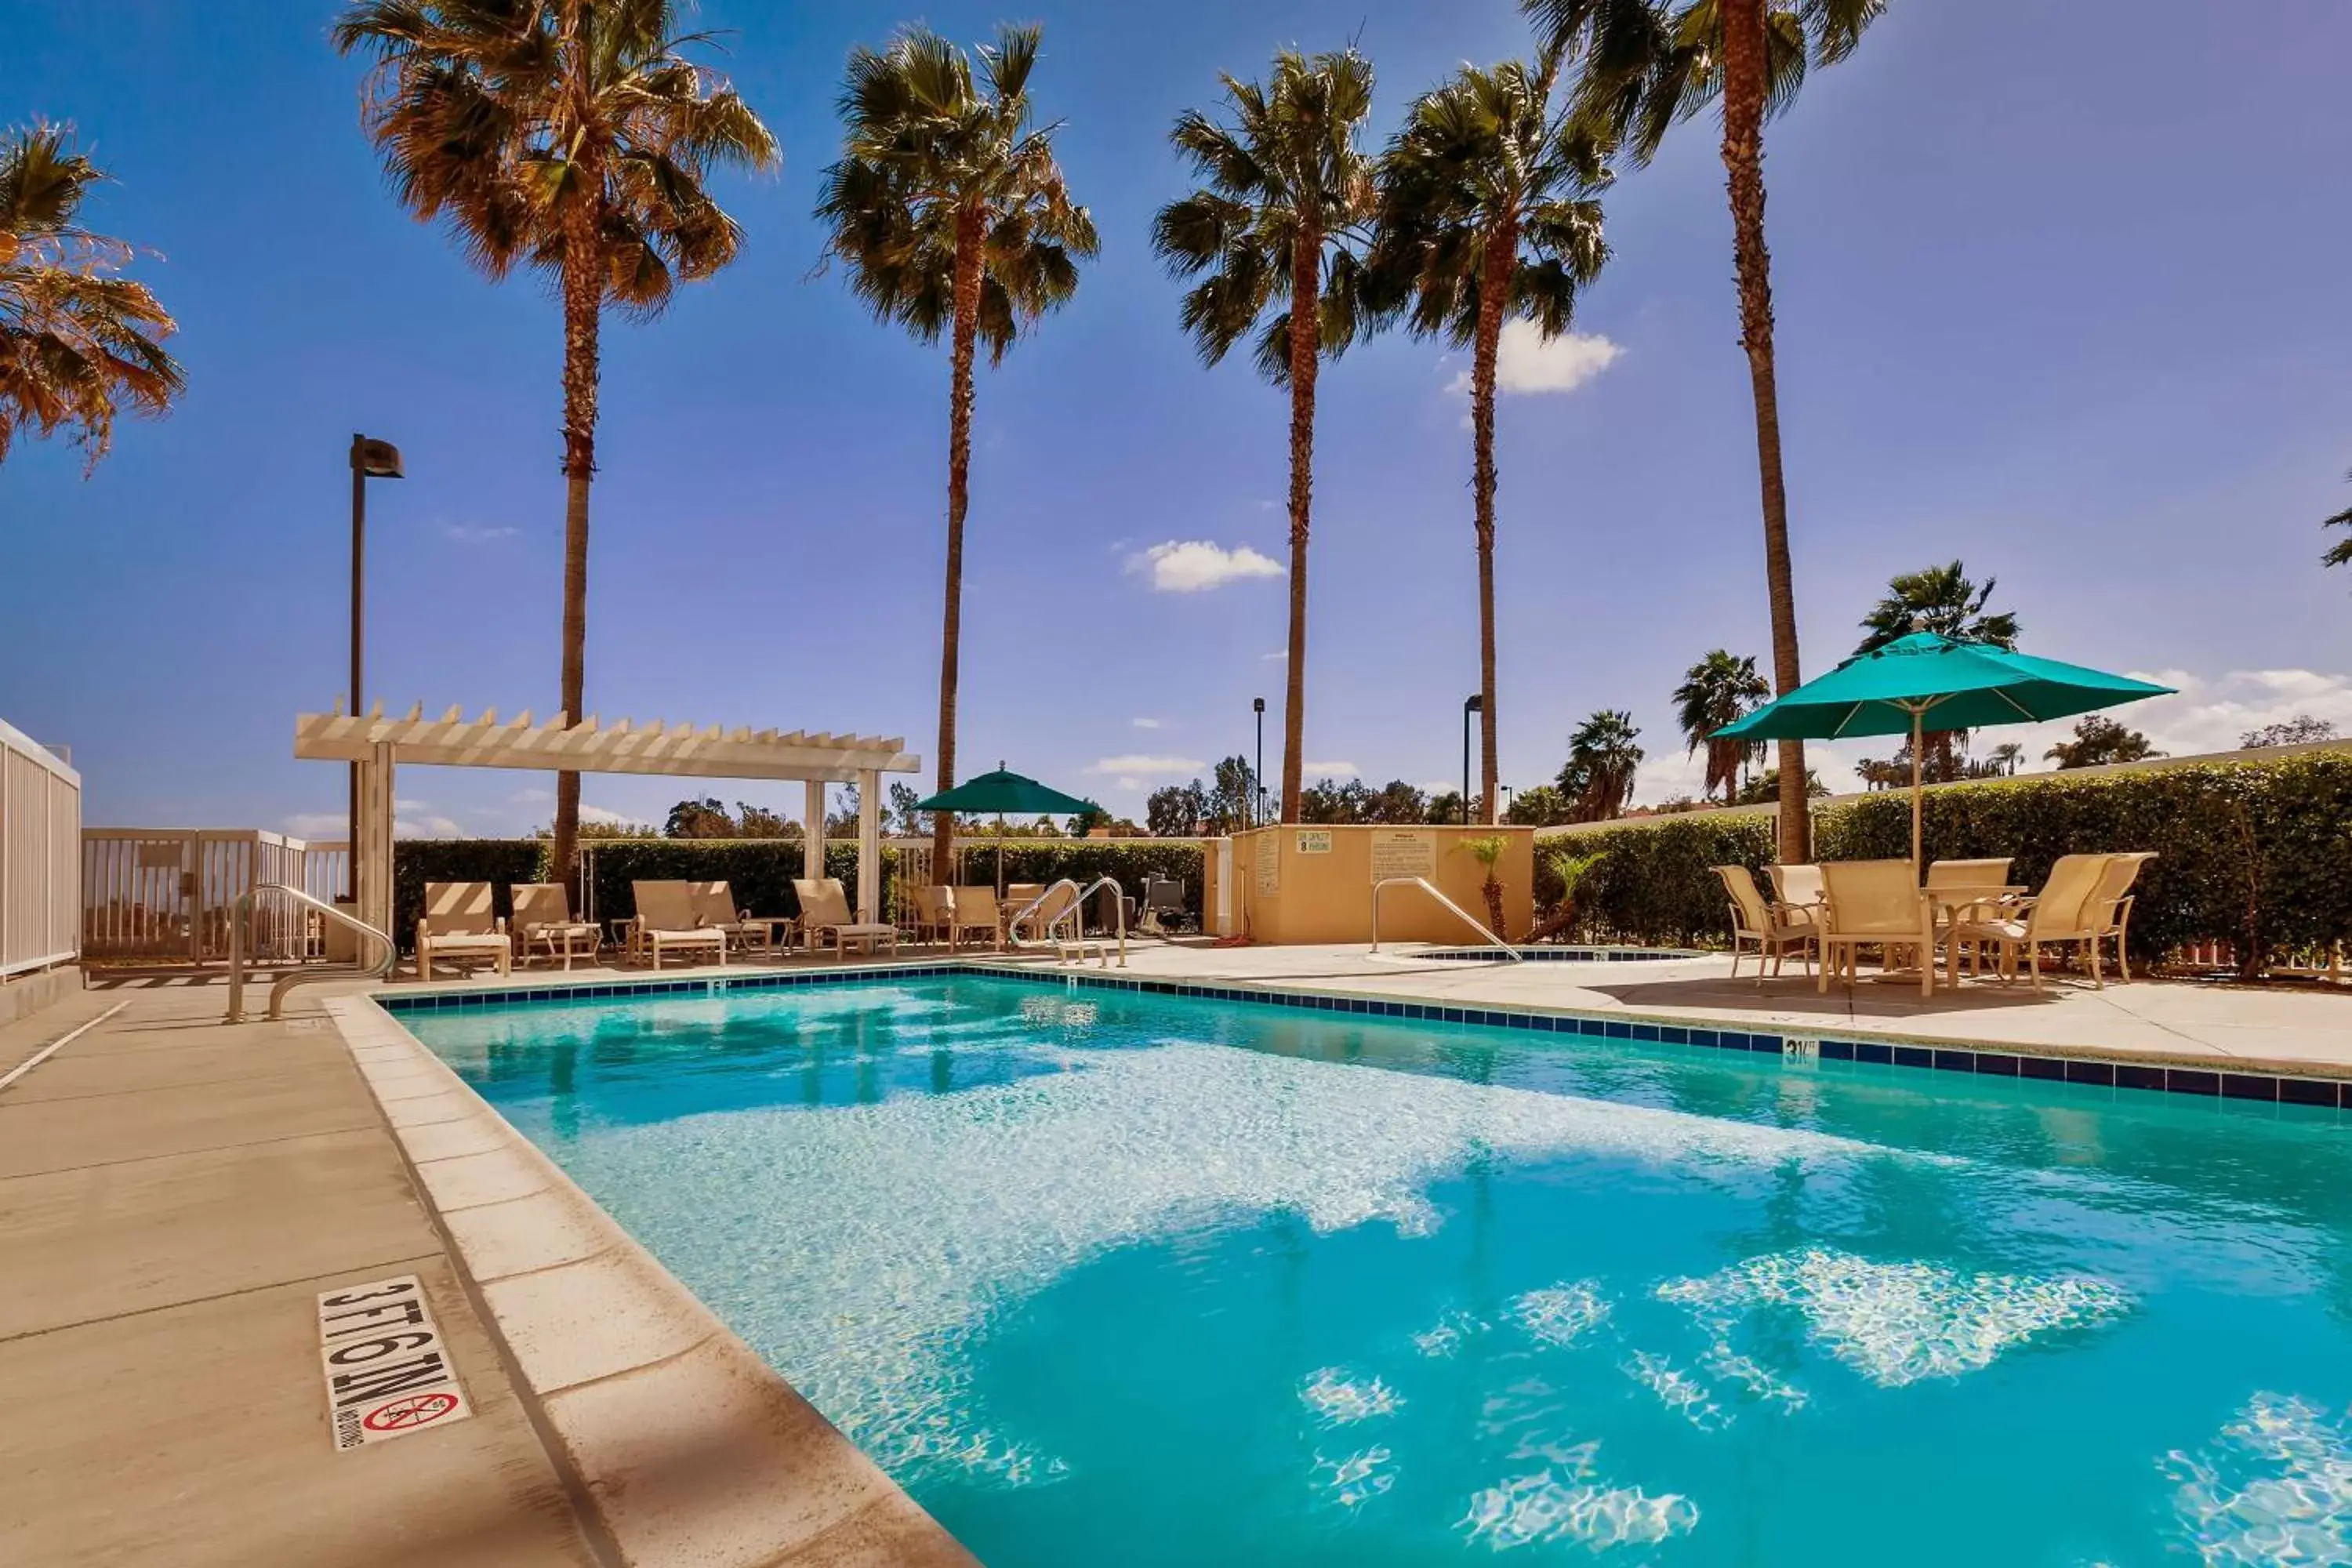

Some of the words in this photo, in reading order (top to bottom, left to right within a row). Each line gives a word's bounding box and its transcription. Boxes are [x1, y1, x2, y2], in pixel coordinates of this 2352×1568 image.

[1301, 841, 1307, 852] 8
[323, 1283, 414, 1306] 3
[325, 1299, 423, 1338] FT
[328, 1332, 434, 1365] 6
[332, 1352, 448, 1407] IN
